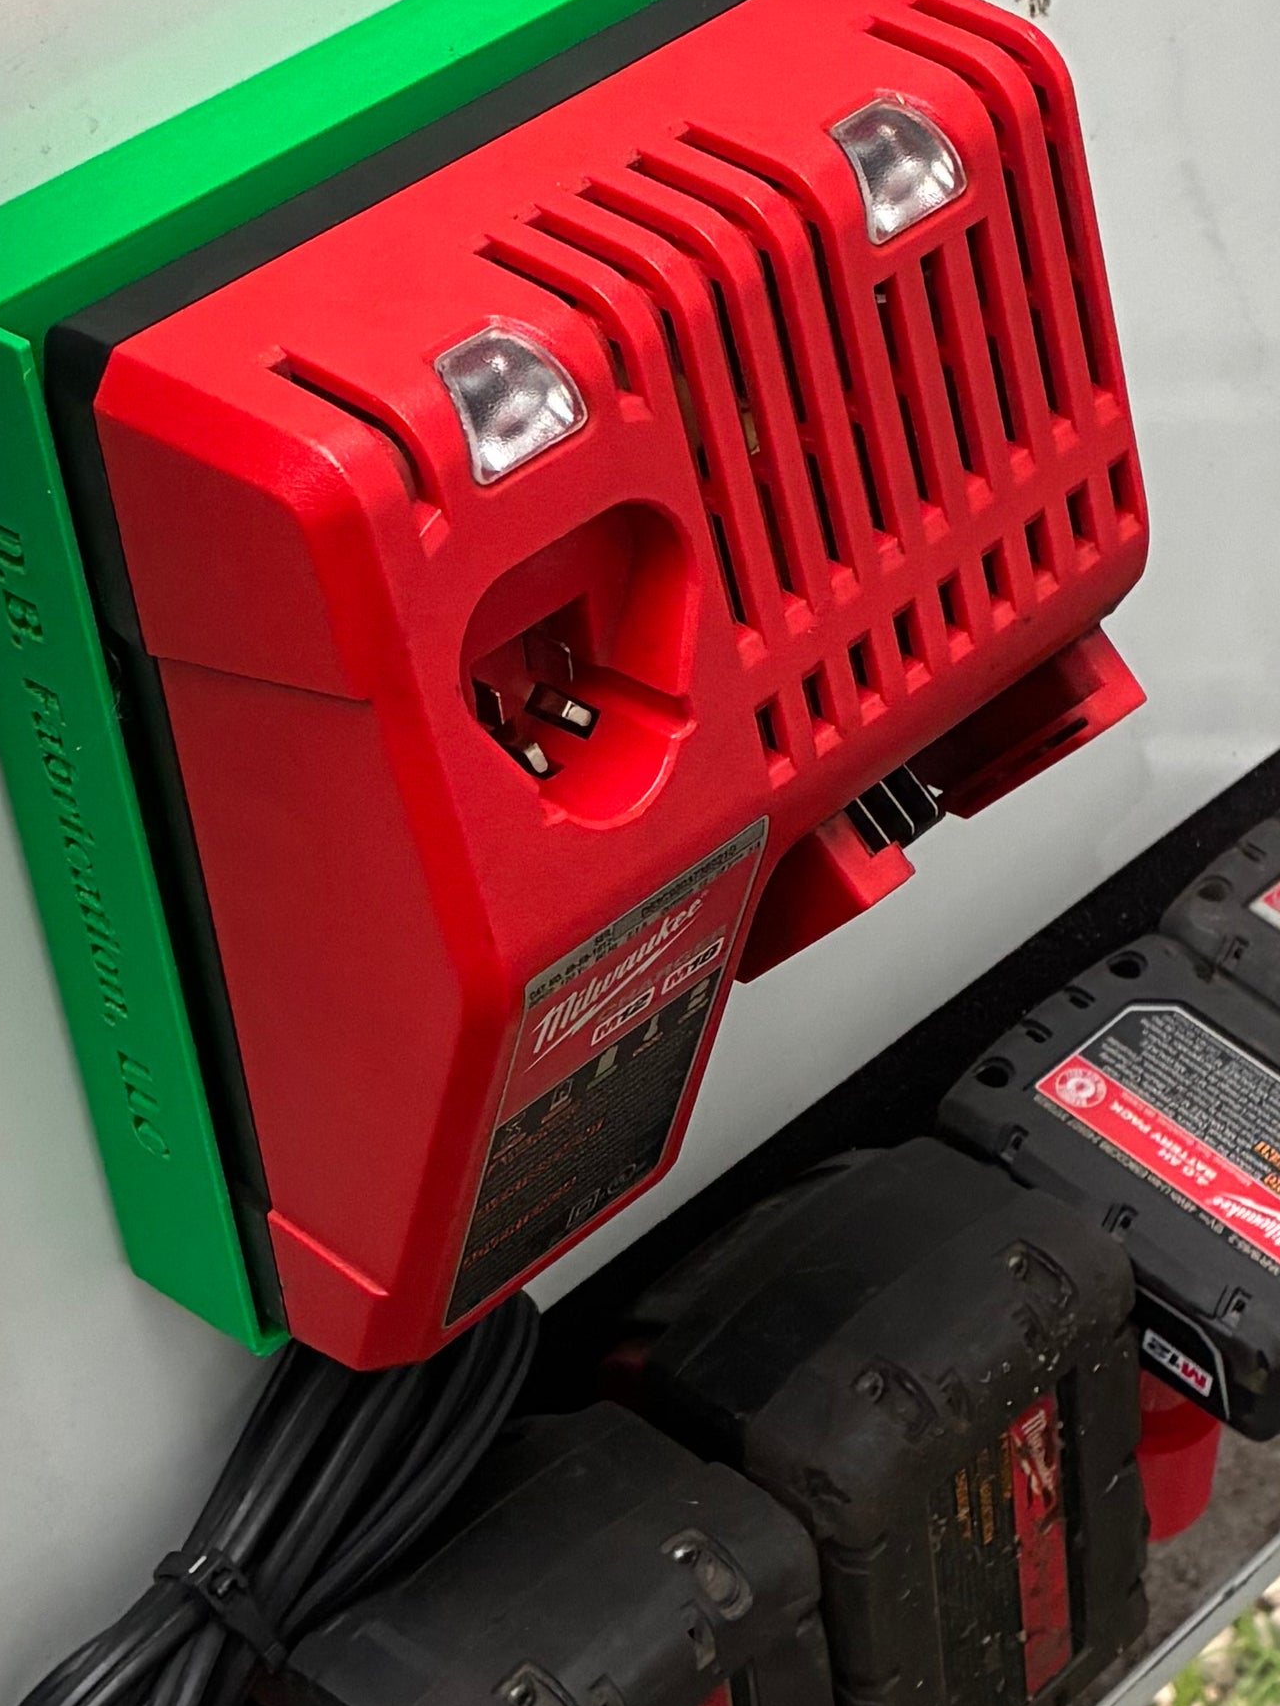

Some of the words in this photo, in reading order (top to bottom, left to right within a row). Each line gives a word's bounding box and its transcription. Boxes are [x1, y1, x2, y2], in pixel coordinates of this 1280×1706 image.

[531, 898, 703, 1054] Milwaukee
[596, 991, 653, 1041] M12
[667, 941, 723, 990] M18
[1110, 1101, 1151, 1134] PACK
[1150, 1132, 1217, 1180] BATTERY
[1147, 1336, 1207, 1389] M12
